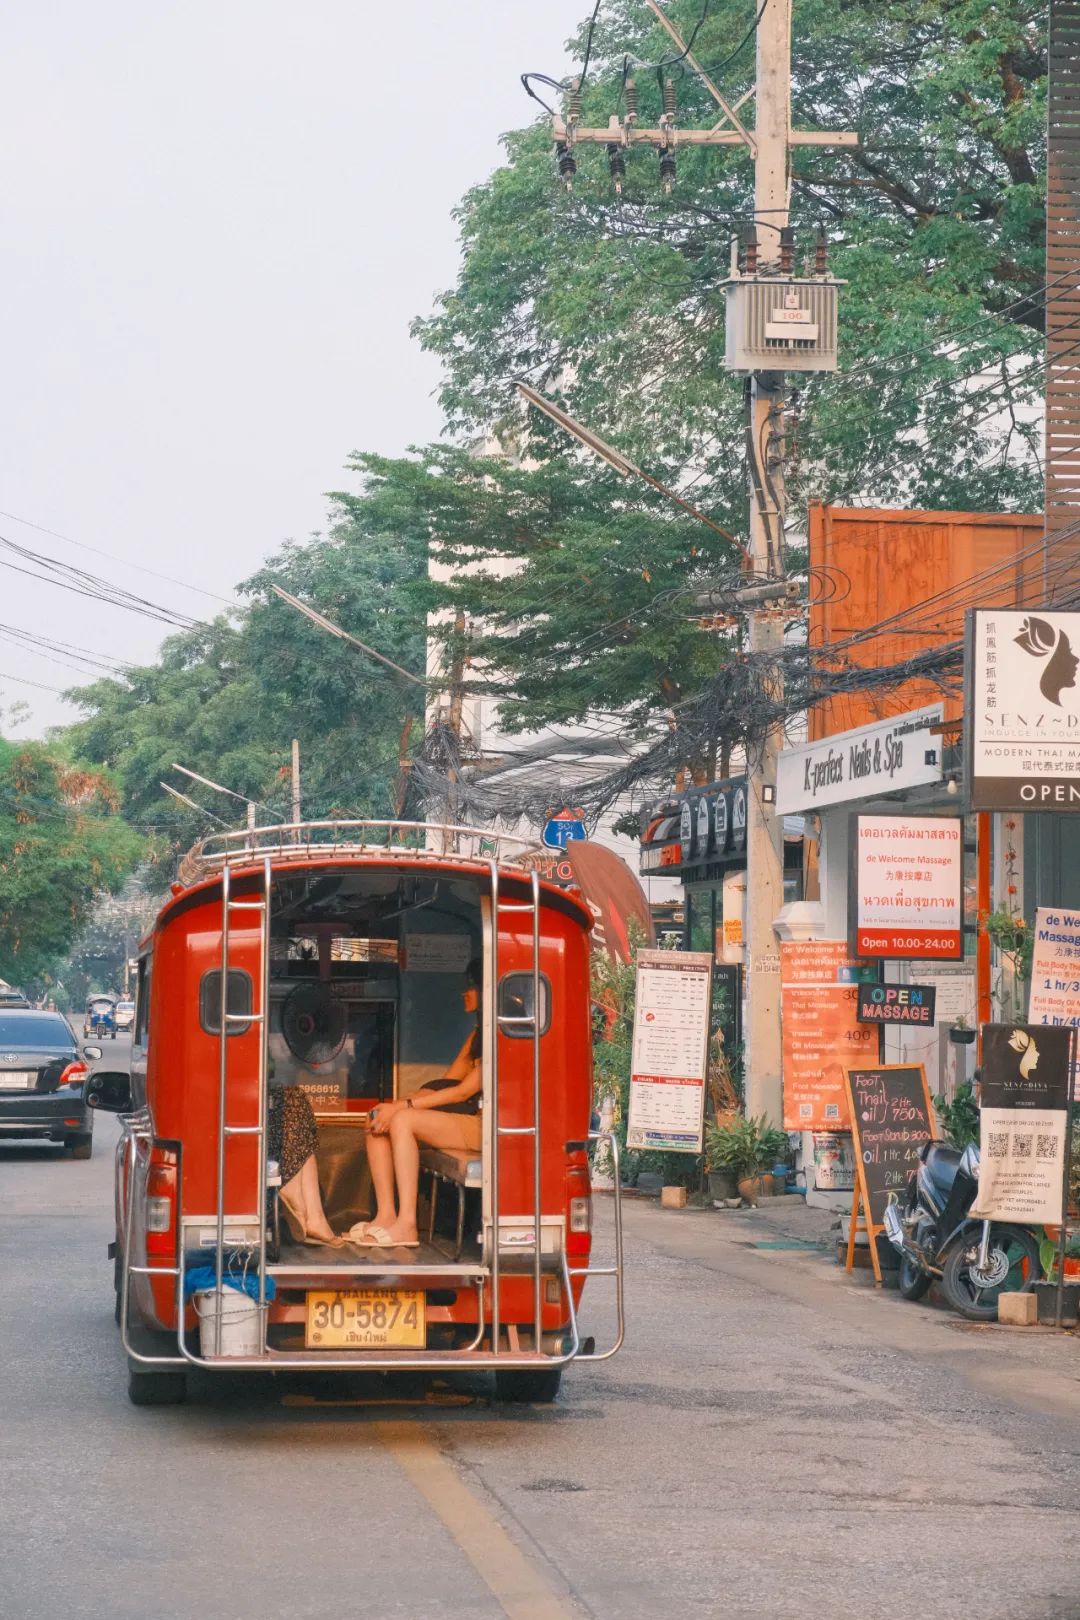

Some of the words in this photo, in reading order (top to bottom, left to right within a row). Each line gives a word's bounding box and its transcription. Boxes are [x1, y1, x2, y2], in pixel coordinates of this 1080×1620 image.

[984, 748, 1032, 756] MODERN
[1038, 749, 1063, 757] THAI
[804, 748, 844, 796] K-perfect
[848, 738, 872, 780] Nails
[873, 738, 882, 774] &
[884, 734, 904, 778] Spa
[1020, 784, 1080, 802] OPEN
[879, 855, 916, 864] Welcome
[917, 856, 952, 866] Massage
[1046, 914, 1060, 926] de
[862, 937, 888, 950] Open
[892, 938, 955, 949] 10.00-24.00
[1044, 979, 1051, 989] 1
[871, 988, 923, 1005] OPEN
[862, 1003, 929, 1021] MASSAGE
[1042, 1014, 1049, 1024] 1
[844, 1031, 871, 1040] 400
[885, 1171, 892, 1185] 2
[314, 1300, 417, 1330] 30-5874
